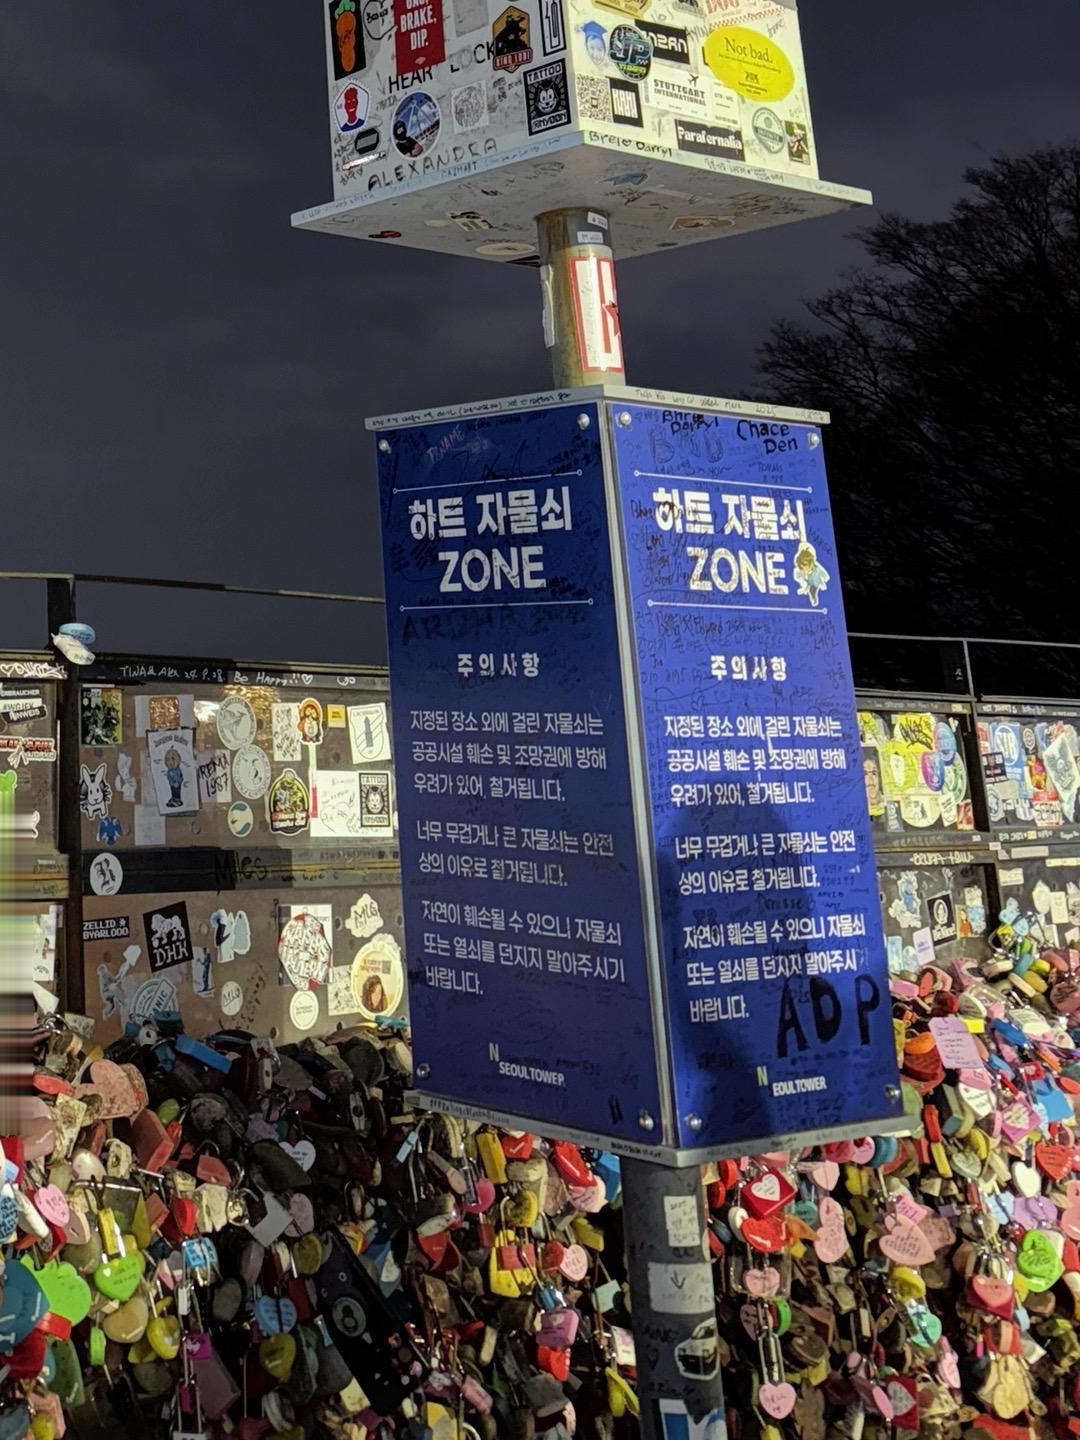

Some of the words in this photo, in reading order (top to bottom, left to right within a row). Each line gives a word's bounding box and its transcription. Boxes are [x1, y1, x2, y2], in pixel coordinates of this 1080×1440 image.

[400, 5, 437, 32] BRAKE,
[410, 29, 429, 50] DIP.
[724, 37, 747, 57] Not
[749, 43, 773, 63] bad.
[527, 62, 561, 83] TATTOO
[654, 79, 705, 99] STUTTGART
[654, 89, 706, 106] INTERNATIONAL
[678, 126, 742, 150] Parafernalia
[763, 438, 798, 454] Den
[408, 496, 467, 540] 하트
[476, 486, 572, 535] 자물쇠
[652, 487, 714, 536] 하트
[721, 493, 807, 542] 자물쇠
[438, 545, 547, 592] ZONE
[686, 547, 789, 595] ZONE
[234, 672, 249, 683] Be
[410, 710, 449, 732] 지정된
[451, 711, 479, 732] 장소
[481, 712, 509, 733] 외에
[512, 712, 540, 733] 걸린
[543, 713, 604, 735] 자물쇠는
[664, 716, 704, 738] 지정된
[707, 716, 734, 737] 장소
[736, 716, 763, 738] 외에
[765, 716, 791, 737] 걸린
[793, 716, 842, 737] 자물쇠는
[411, 741, 463, 764] 공공시설
[466, 743, 493, 765] 훼손
[497, 744, 511, 765] 및
[514, 745, 572, 768] 조망권에
[576, 747, 607, 770] 방해
[667, 749, 721, 772] 공공시설
[723, 749, 750, 771] 훼손
[753, 749, 766, 771] 및
[769, 749, 819, 770] 조망권에
[820, 748, 847, 769] 방해
[362, 776, 386, 784] TATTOO
[414, 773, 453, 795] 우려가
[456, 775, 486, 799] 있어,
[489, 776, 566, 801] 철거됩니다.
[670, 784, 712, 808] 우려가
[714, 783, 745, 807] 있어,
[747, 782, 815, 805] 철거됩니다.
[416, 820, 442, 841] 너무
[446, 822, 500, 847] 무겁거나
[502, 826, 517, 848] 큰
[521, 828, 579, 854] 자물쇠는
[582, 832, 615, 857] 안전
[675, 836, 703, 859] 너무
[706, 835, 758, 858] 무겁거나
[761, 833, 775, 855] 큰
[778, 832, 827, 854] 자물쇠는
[830, 831, 856, 852] 안전
[418, 852, 444, 875] 상의
[447, 854, 488, 879] 이유로
[491, 859, 568, 887] 철거됩니다.
[678, 873, 706, 895] 상의
[709, 870, 749, 894] 이유로
[752, 866, 820, 891] 철거됩니다.
[422, 900, 461, 925] 자연이
[464, 905, 506, 932] 훼손될
[509, 911, 524, 934] 수
[527, 913, 571, 940] 있으니
[575, 919, 622, 947] 자물쇠
[683, 925, 724, 949] 자연이
[727, 921, 768, 946] 훼손될
[770, 921, 783, 942] 수
[786, 917, 825, 941] 있으니
[829, 914, 866, 937] 자물쇠
[423, 932, 451, 957] 또는
[453, 937, 495, 964] 열쇠를
[499, 943, 543, 971] 던지지
[547, 949, 626, 984] 말아주시기
[687, 963, 715, 986] 또는
[718, 958, 759, 983] 열쇠를
[762, 954, 802, 979] 던지지
[805, 949, 869, 975] 말아주시
[425, 966, 484, 995] 바랍니다.
[689, 995, 750, 1023] 바랍니다.
[777, 973, 880, 1059] ADP
[489, 1043, 500, 1061] N
[756, 1066, 768, 1087] N
